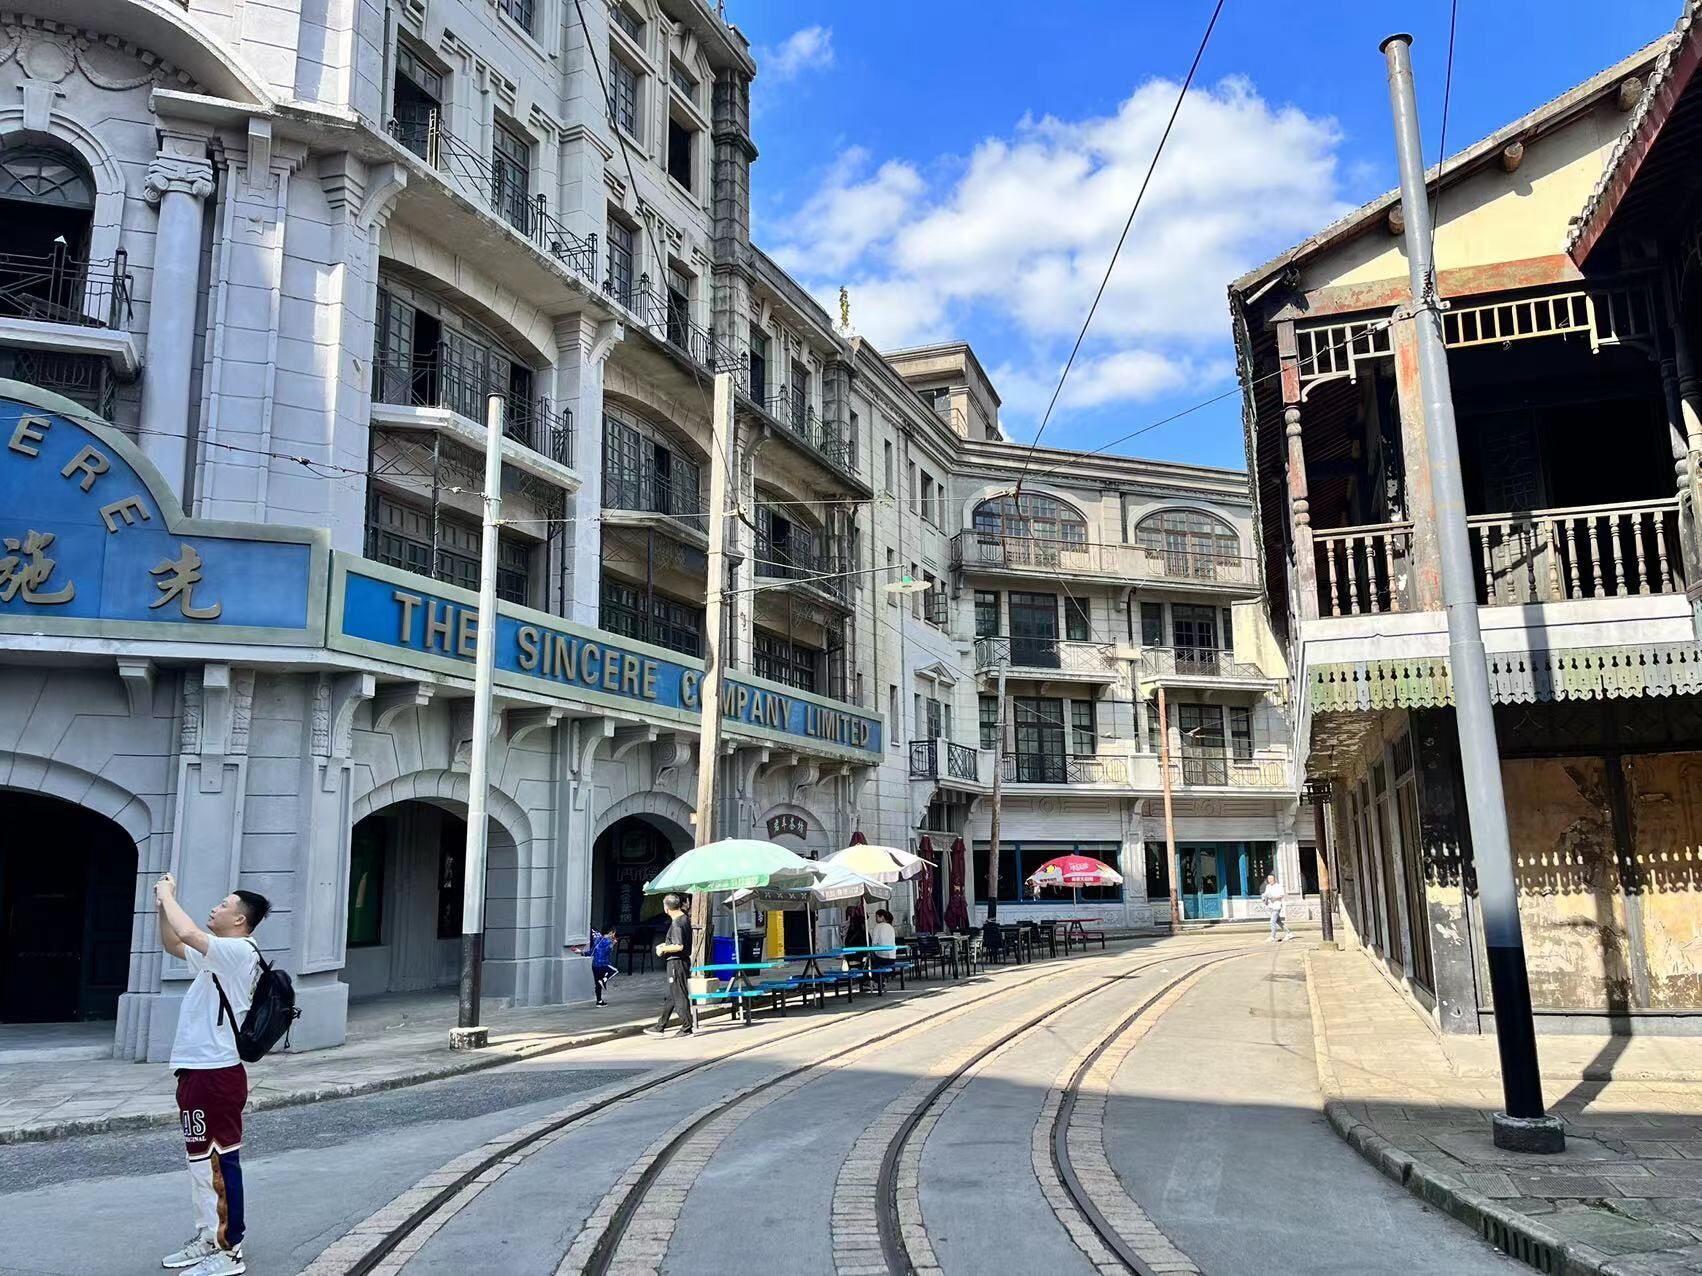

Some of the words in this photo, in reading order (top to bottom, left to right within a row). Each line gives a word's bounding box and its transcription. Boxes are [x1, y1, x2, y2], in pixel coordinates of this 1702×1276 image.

[393, 591, 478, 657] THE
[516, 625, 658, 700] SINCERE
[681, 670, 793, 730] CMPANY
[804, 704, 870, 748] LIMITED
